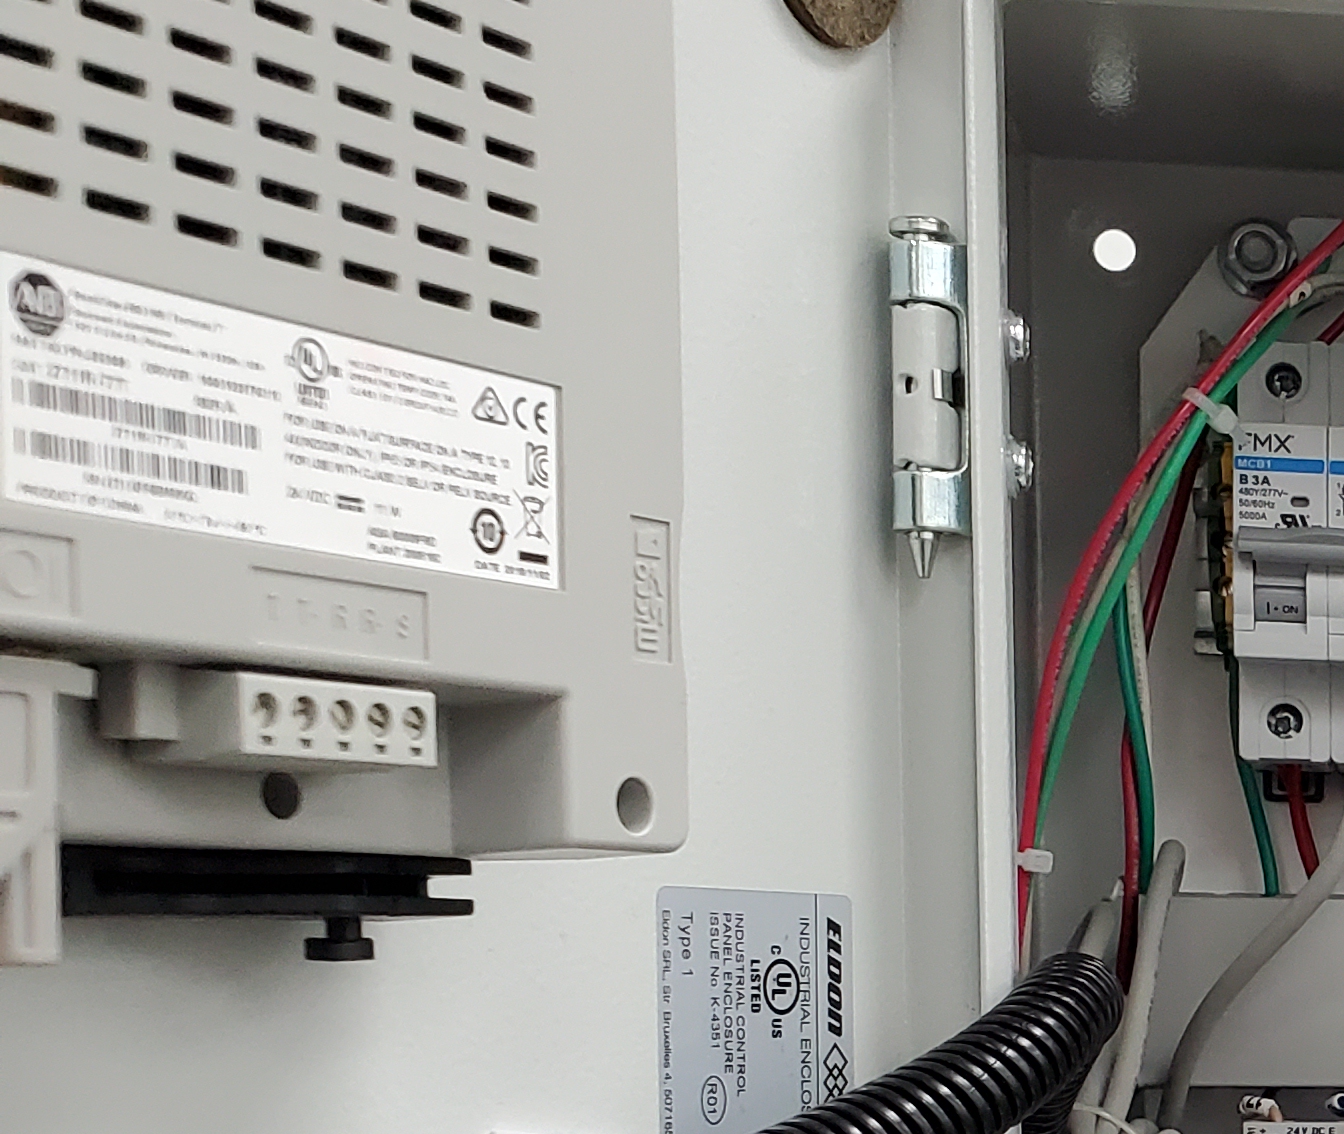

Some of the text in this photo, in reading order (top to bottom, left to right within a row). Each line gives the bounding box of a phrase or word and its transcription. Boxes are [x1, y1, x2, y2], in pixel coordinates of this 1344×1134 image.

[1239, 474, 1271, 487] B 3A
[1283, 604, 1299, 614] ON
[678, 911, 695, 978] Type 1
[709, 911, 721, 961] ISSUE
[722, 911, 734, 1075] PANEL ENCLOSURE
[750, 958, 762, 1014] LISTED
[799, 916, 812, 1033] INDUSTRIAL
[710, 996, 721, 1050] K-4351
[734, 912, 747, 1098] INDUSTRIAL CONTROL
[771, 1018, 783, 1039] US
[706, 1082, 719, 1115] R01
